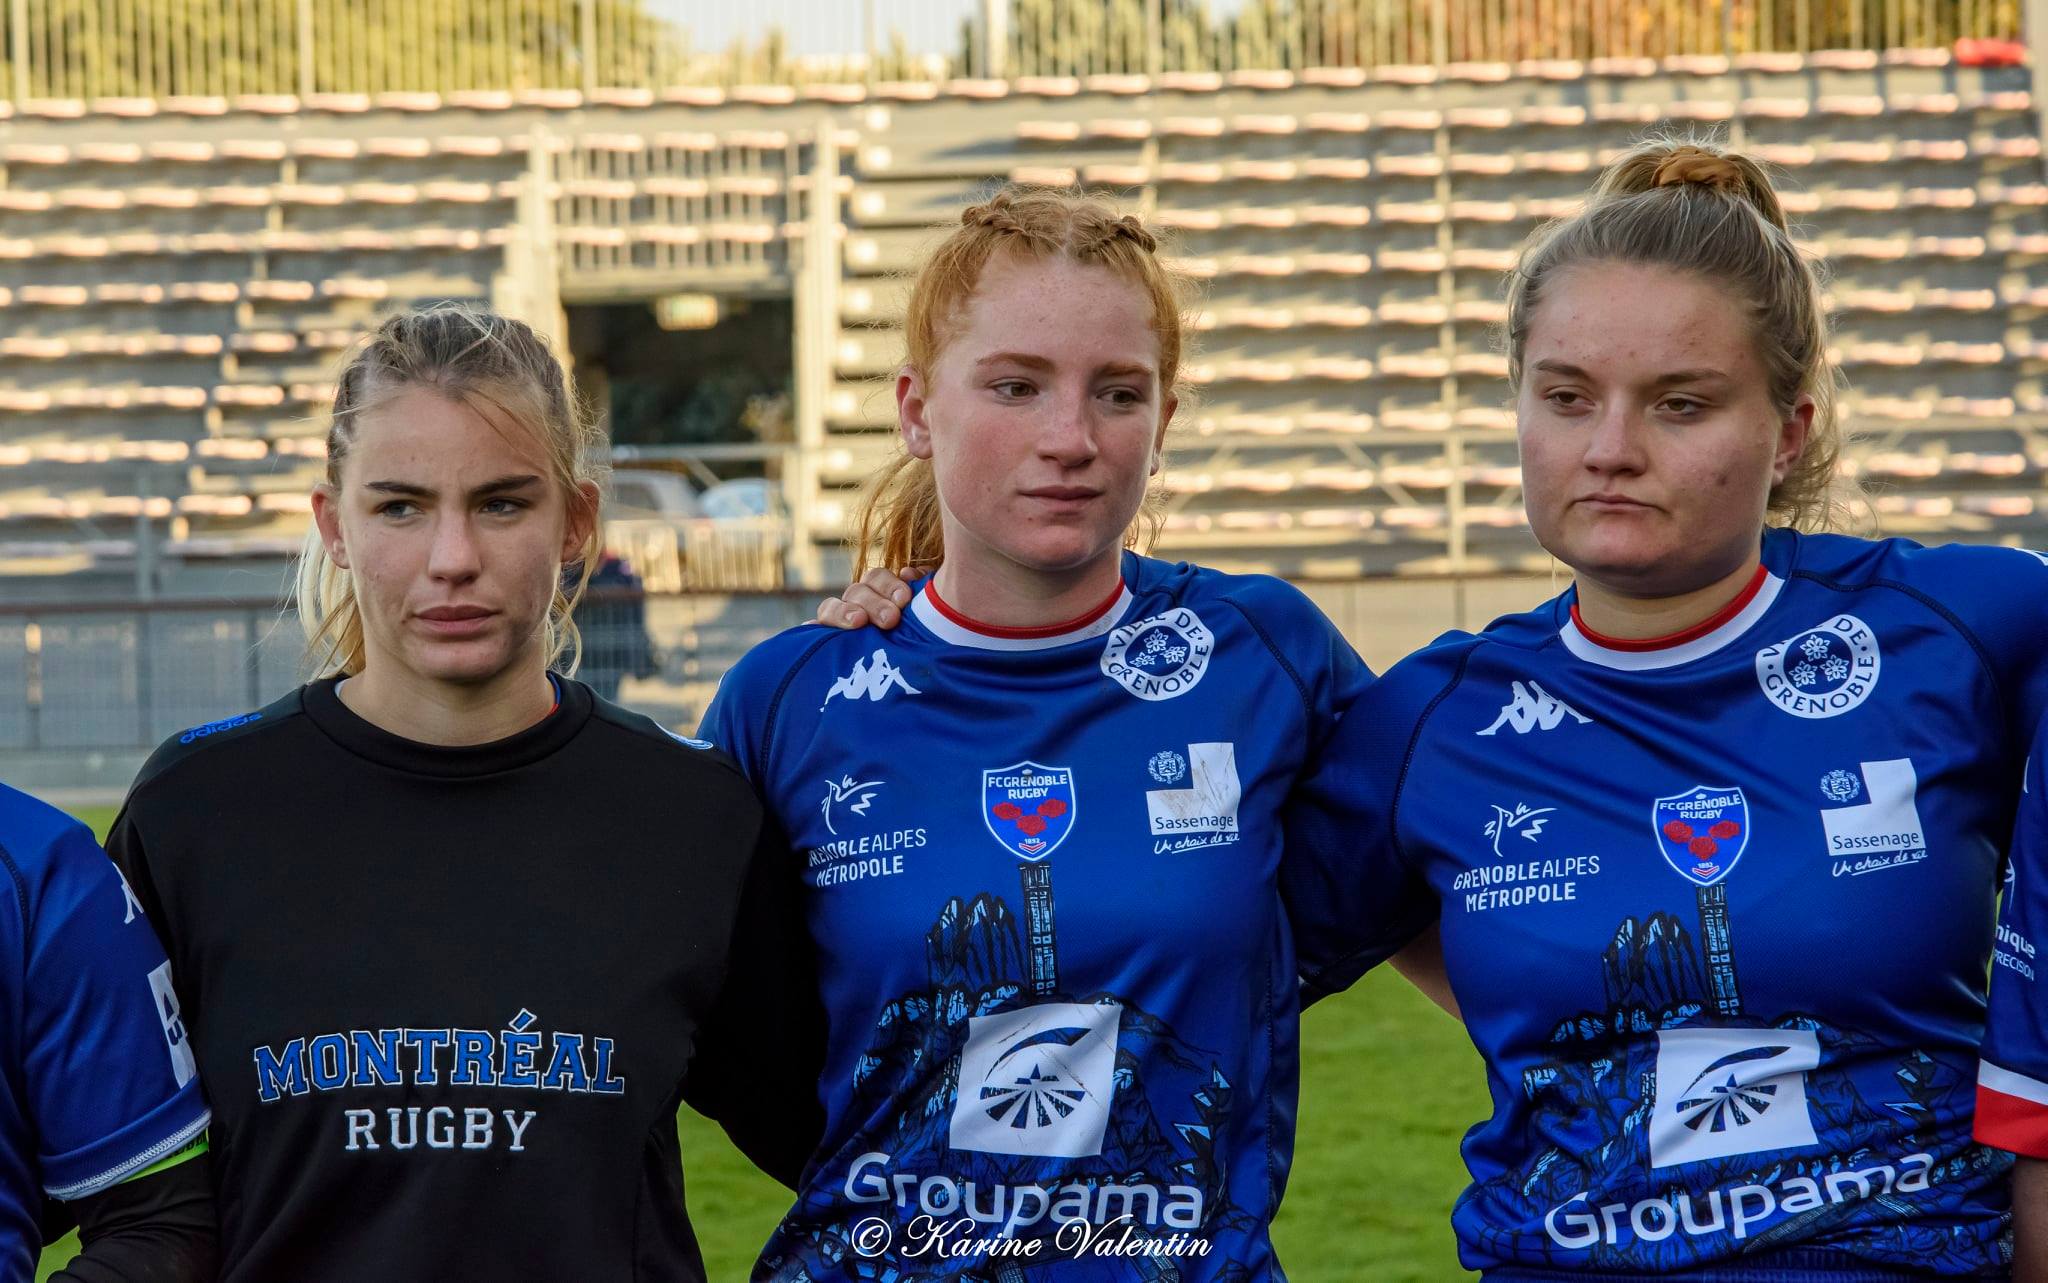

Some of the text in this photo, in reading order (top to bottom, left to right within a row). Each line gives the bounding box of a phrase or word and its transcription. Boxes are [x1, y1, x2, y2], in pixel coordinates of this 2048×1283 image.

[1175, 611, 1203, 639] DE
[1834, 617, 1868, 646] DE
[1108, 645, 1209, 695] GRENOBLE
[1766, 655, 1875, 713] GRENOBLE
[1008, 788, 1049, 799] RUGBY
[1155, 815, 1234, 830] Sassenage
[1680, 809, 1723, 819] RUGBY
[1832, 832, 1919, 850] Sassenage
[816, 855, 904, 888] MÉTROPOLE
[1465, 882, 1577, 913] MÉTROPOLE
[254, 1008, 625, 1102] MONTRÉAL
[344, 1107, 536, 1151] RUGBY
[844, 1152, 1204, 1239] Groupama
[1544, 1153, 1933, 1250] Groupama
